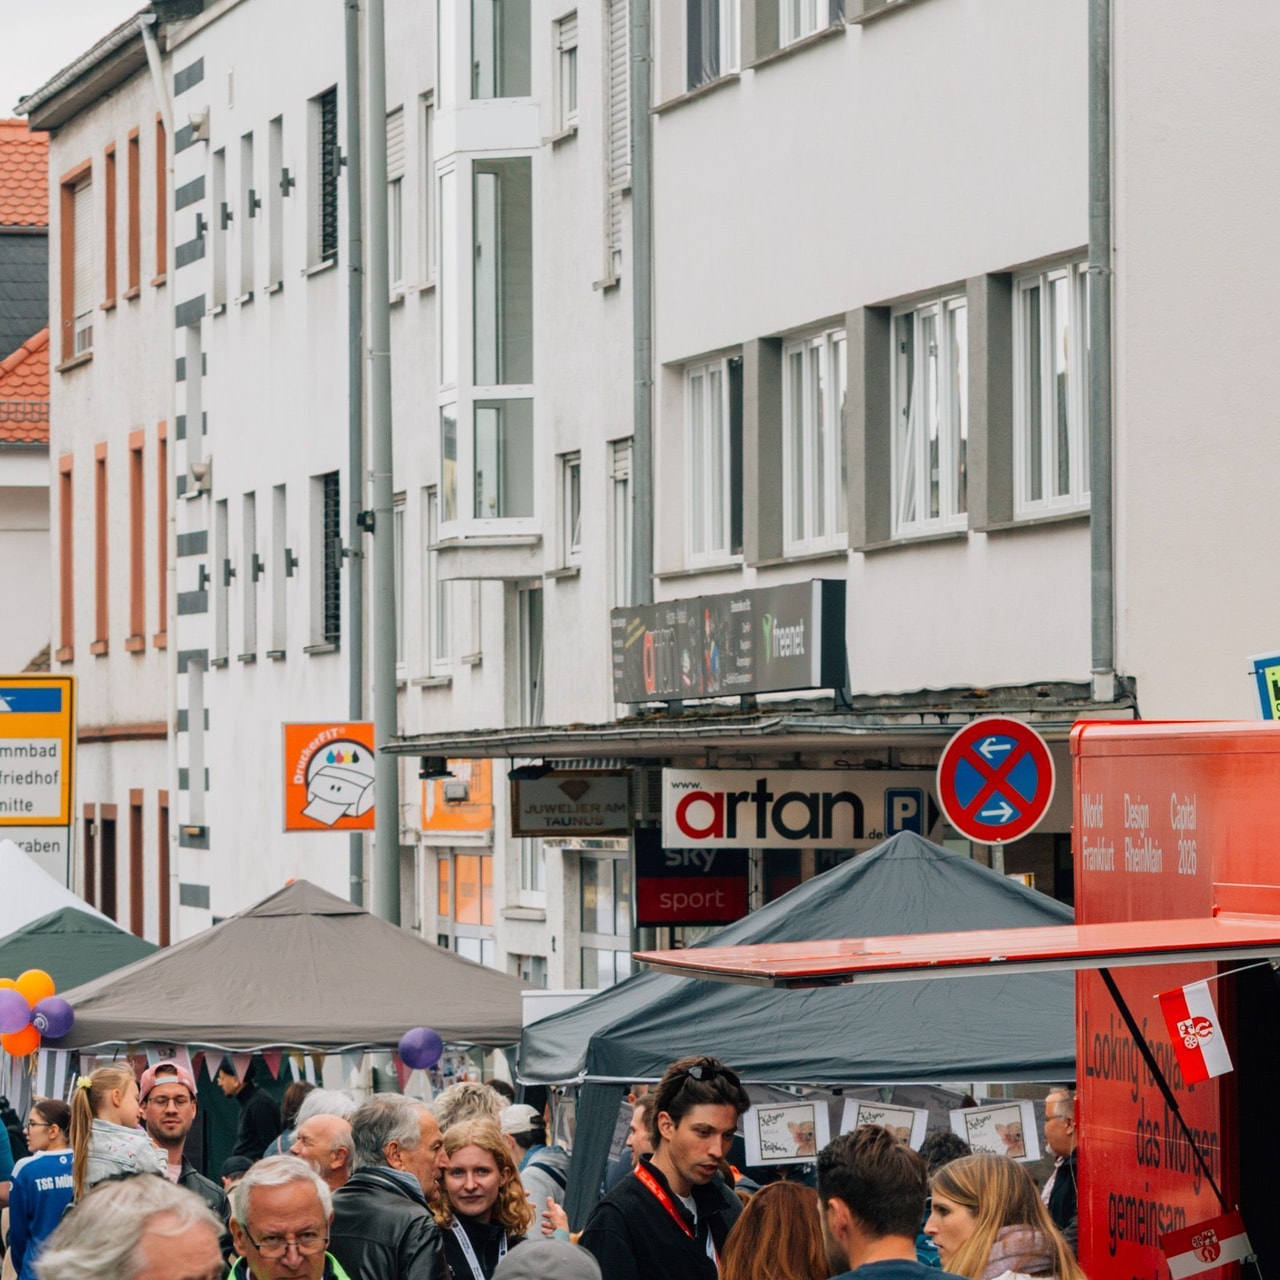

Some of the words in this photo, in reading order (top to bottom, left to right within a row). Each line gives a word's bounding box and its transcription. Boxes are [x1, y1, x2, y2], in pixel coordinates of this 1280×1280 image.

[772, 618, 805, 657] freenet
[293, 727, 338, 784] DruckerFIT
[671, 782, 703, 790] www.
[524, 802, 600, 815] JUWELIER
[604, 802, 626, 814] AM
[544, 817, 604, 827] TAUNUS
[675, 778, 865, 839] artan
[894, 796, 917, 830] P
[1082, 793, 1104, 829] World
[1124, 793, 1149, 837] Design
[1170, 792, 1197, 838] Capital
[1082, 837, 1115, 872] Frankfurt
[1124, 837, 1163, 873] RheinMain
[1178, 839, 1197, 875] 2026
[660, 889, 725, 911] sport
[1085, 1011, 1139, 1103] Looking
[1136, 1097, 1160, 1169] das
[1164, 1100, 1219, 1195] Morgen
[35, 1177, 53, 1191] TSG
[1108, 1182, 1186, 1257] gemeinsam
